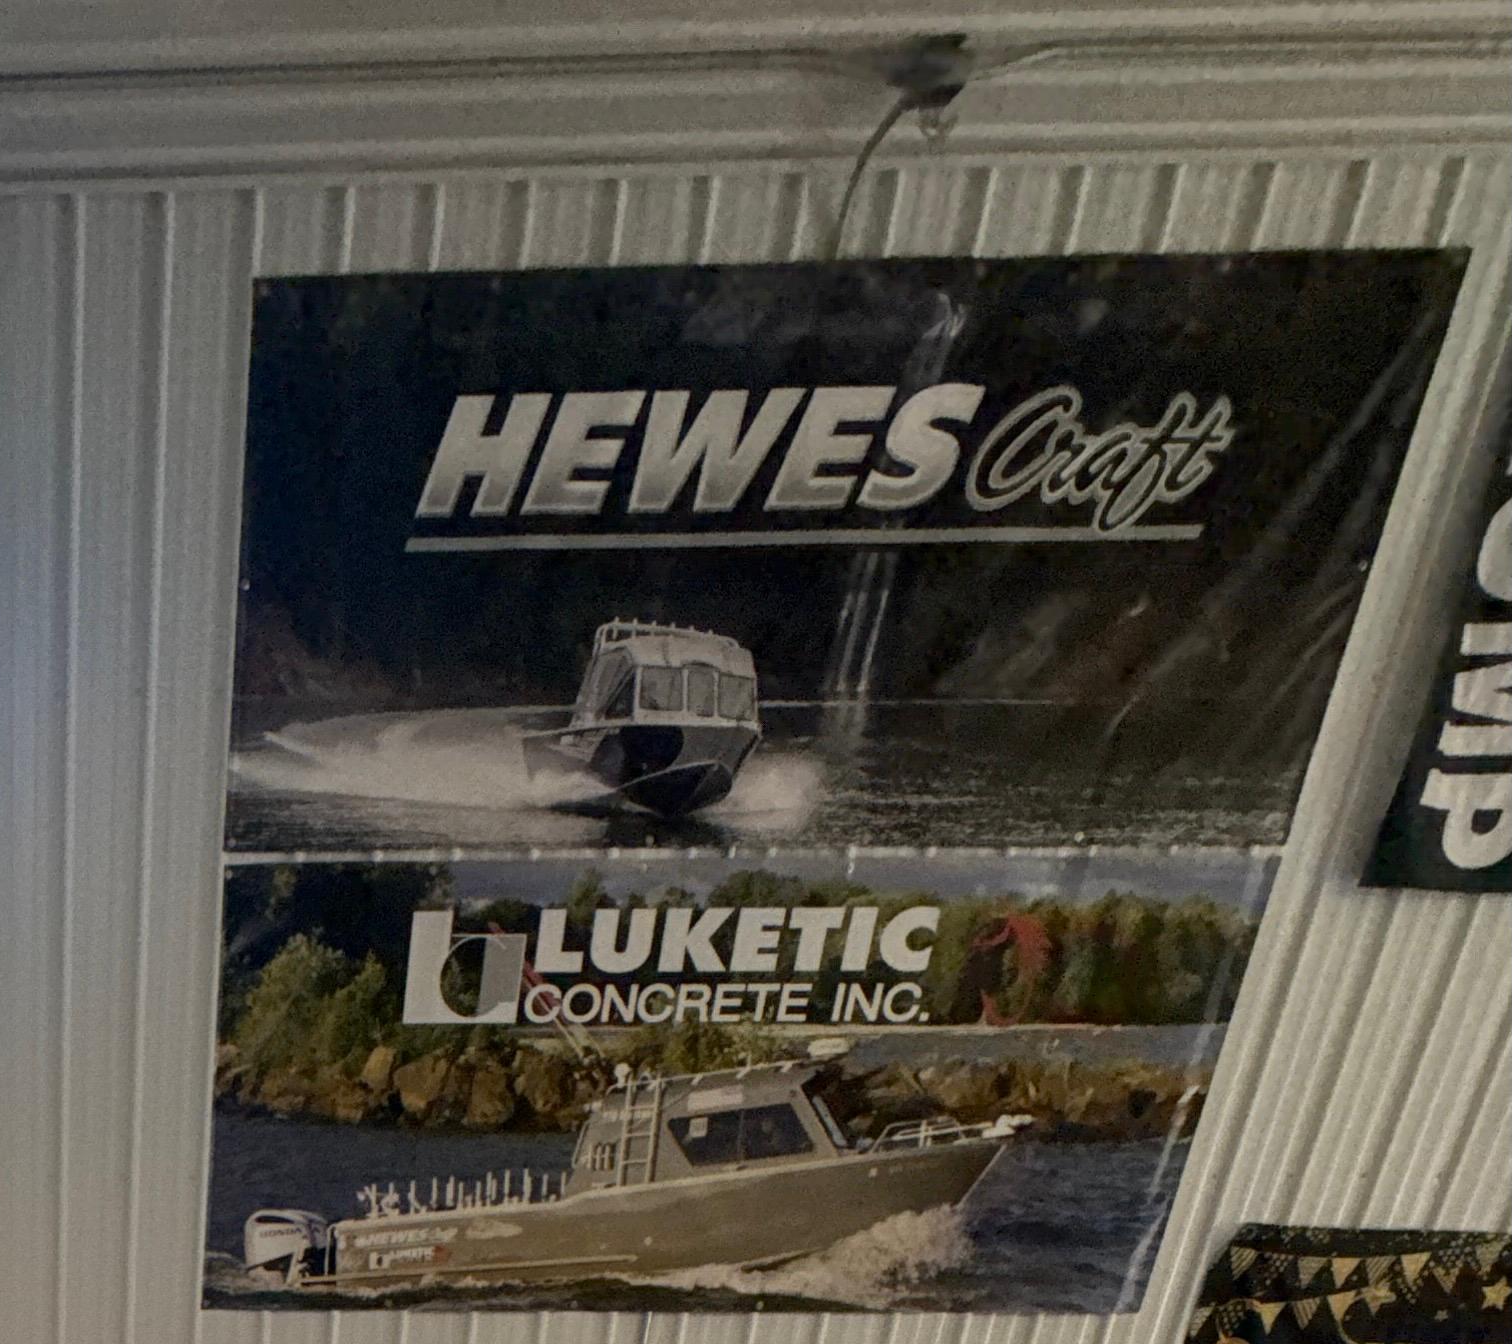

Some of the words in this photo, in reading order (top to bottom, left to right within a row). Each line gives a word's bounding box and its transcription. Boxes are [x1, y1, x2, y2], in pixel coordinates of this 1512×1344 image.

[415, 385, 985, 517] HEWES
[966, 386, 1236, 533] Craft
[534, 906, 940, 974] LUKETIC
[524, 983, 812, 1024] CONCRETE
[831, 982, 929, 1024] INC.
